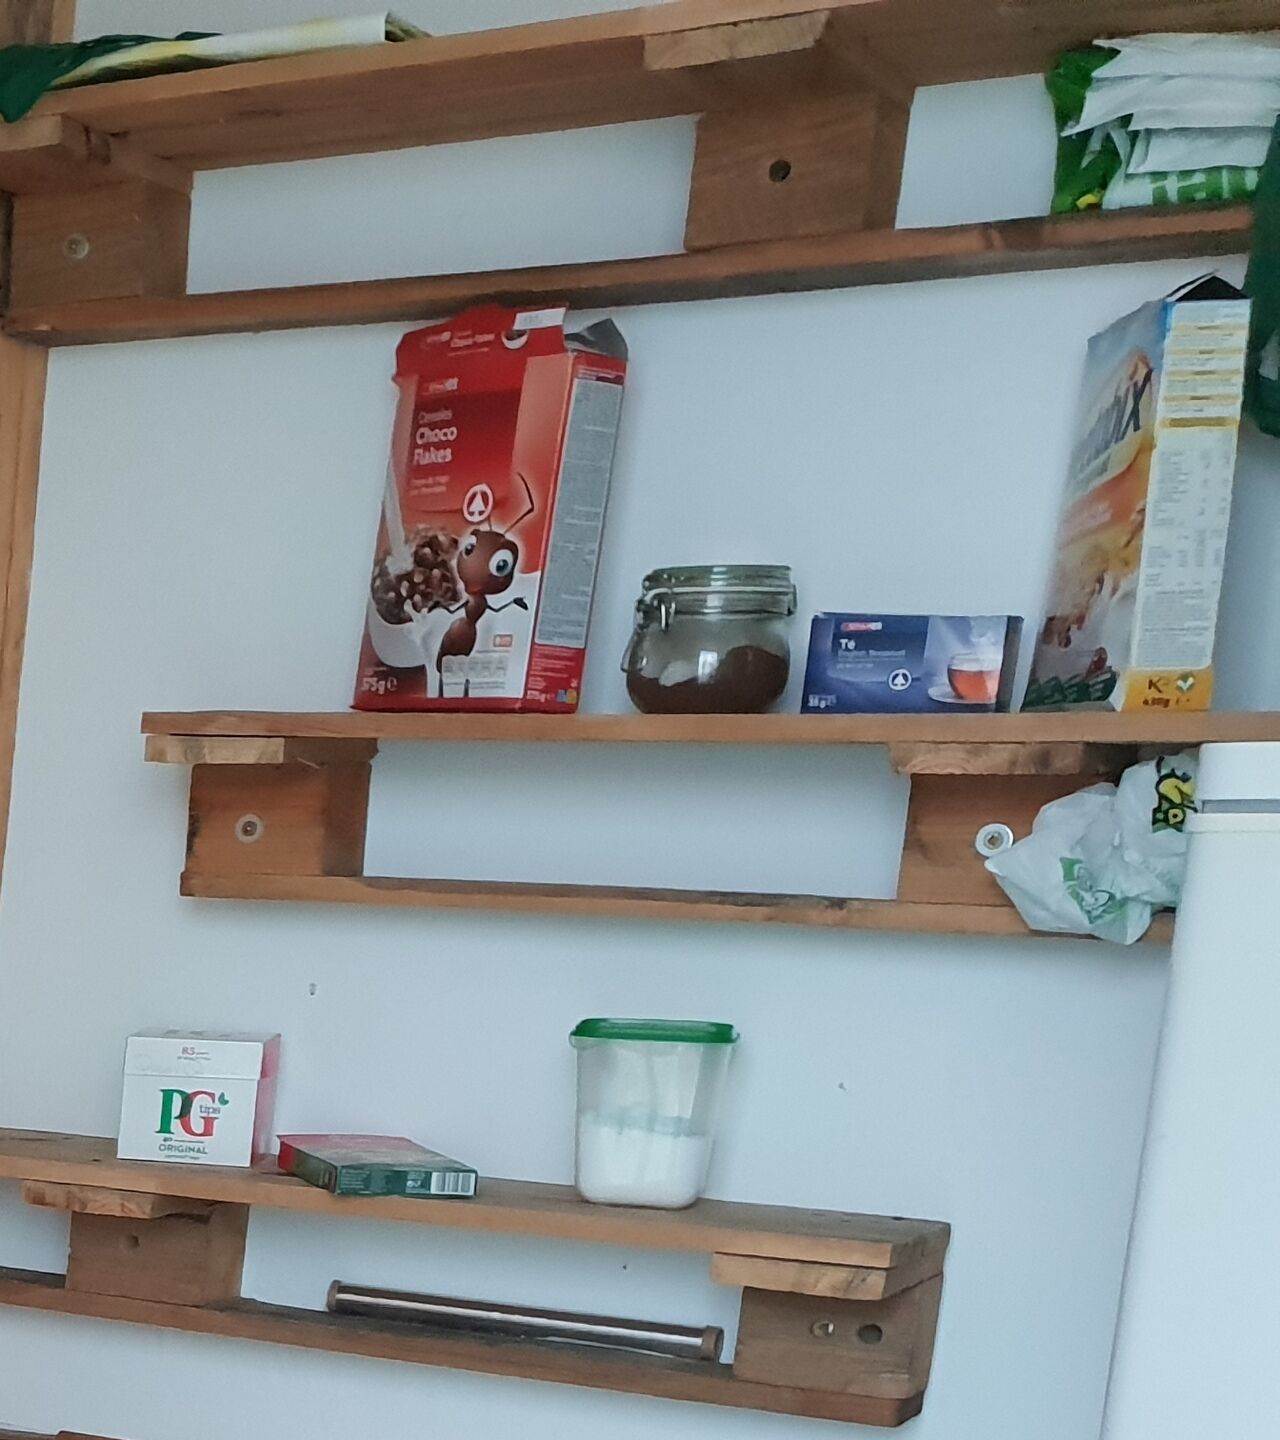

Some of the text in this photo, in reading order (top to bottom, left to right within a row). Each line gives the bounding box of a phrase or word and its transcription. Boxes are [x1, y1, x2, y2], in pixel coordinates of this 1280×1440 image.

[416, 426, 457, 445] Choco
[413, 446, 452, 466] Flakes
[154, 1088, 219, 1138] PG
[199, 1104, 221, 1116] tips
[158, 1143, 209, 1155] ORIGINAL
